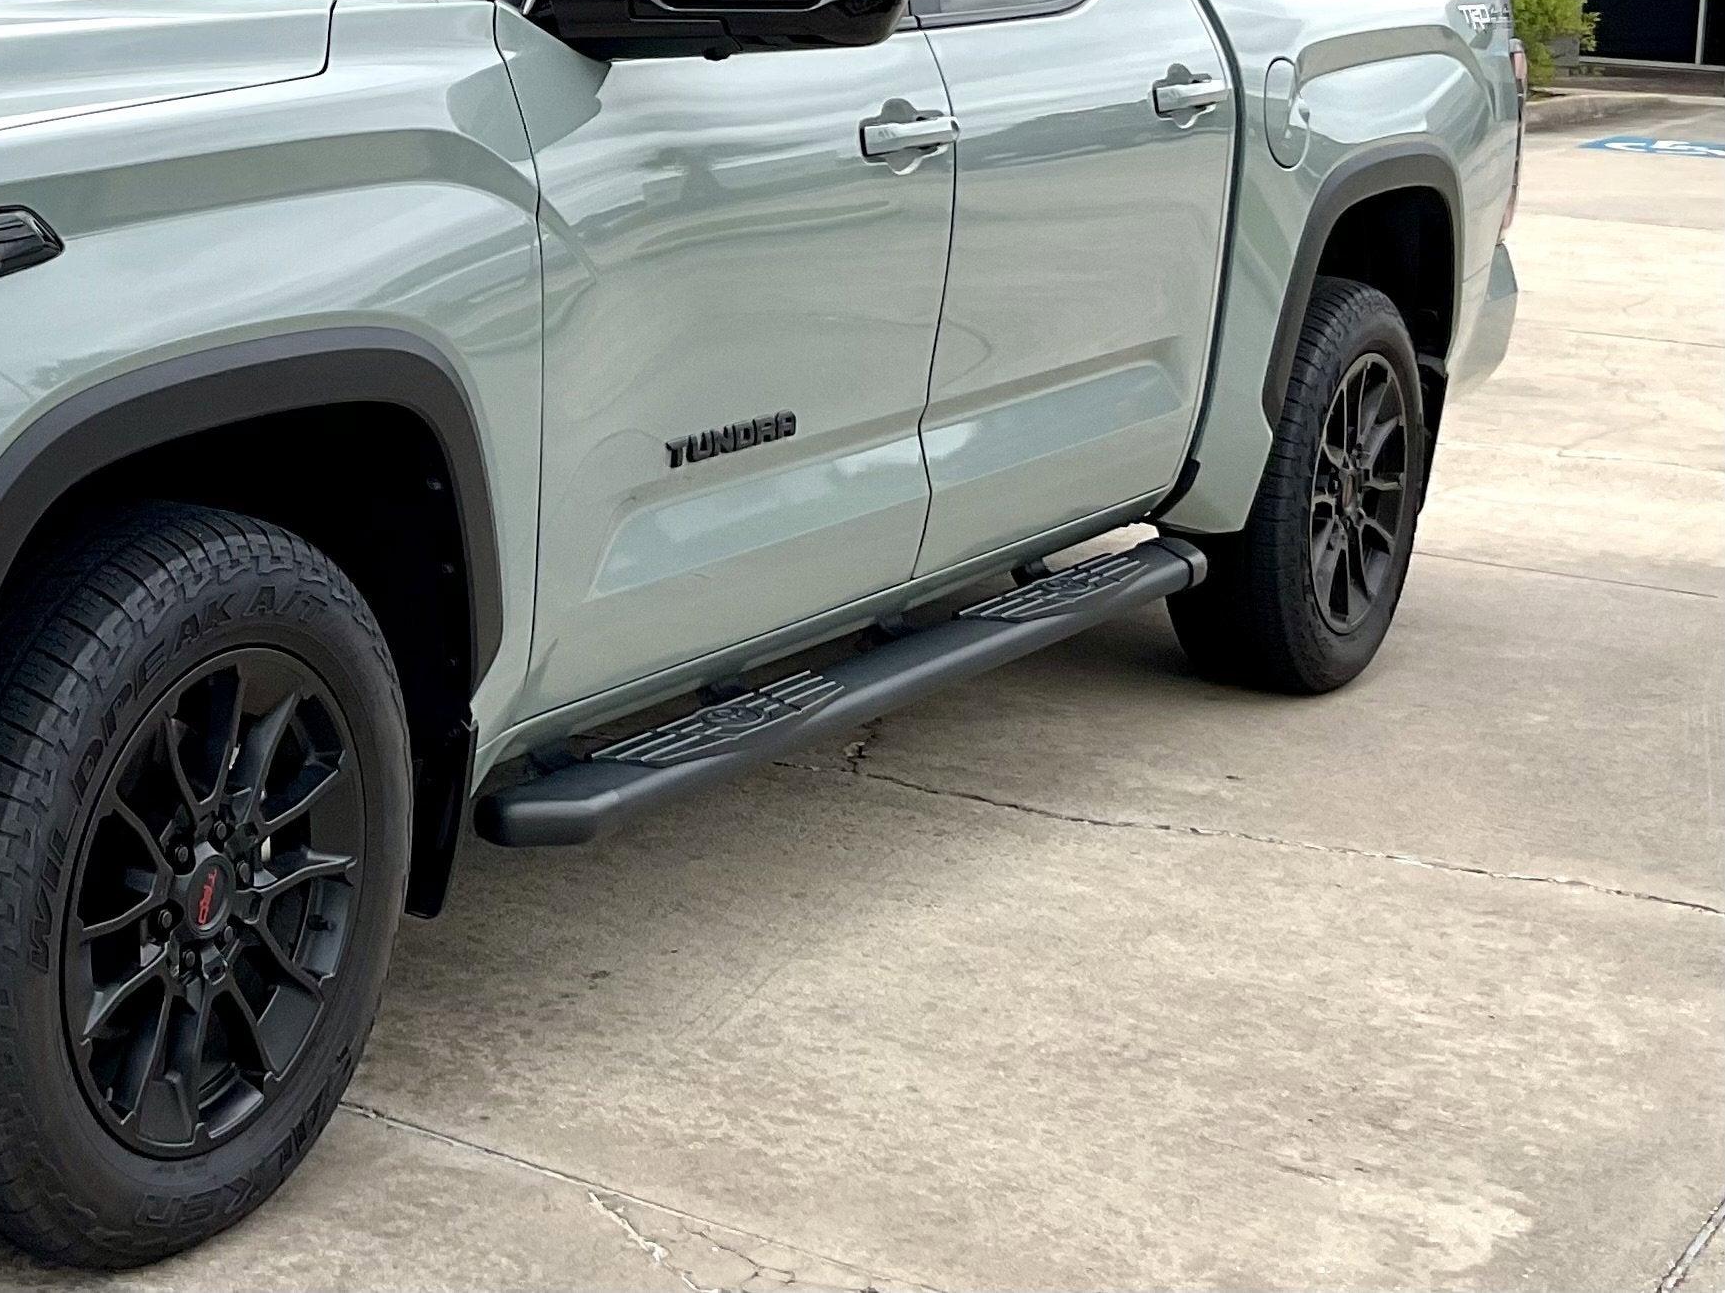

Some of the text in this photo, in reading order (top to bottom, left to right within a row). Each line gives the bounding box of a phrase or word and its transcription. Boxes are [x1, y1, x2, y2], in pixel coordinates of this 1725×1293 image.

[1457, 4, 1490, 30] TRD
[665, 409, 796, 468] TUNDRA
[29, 593, 235, 974] WILDPEAK
[198, 866, 219, 925] TRD
